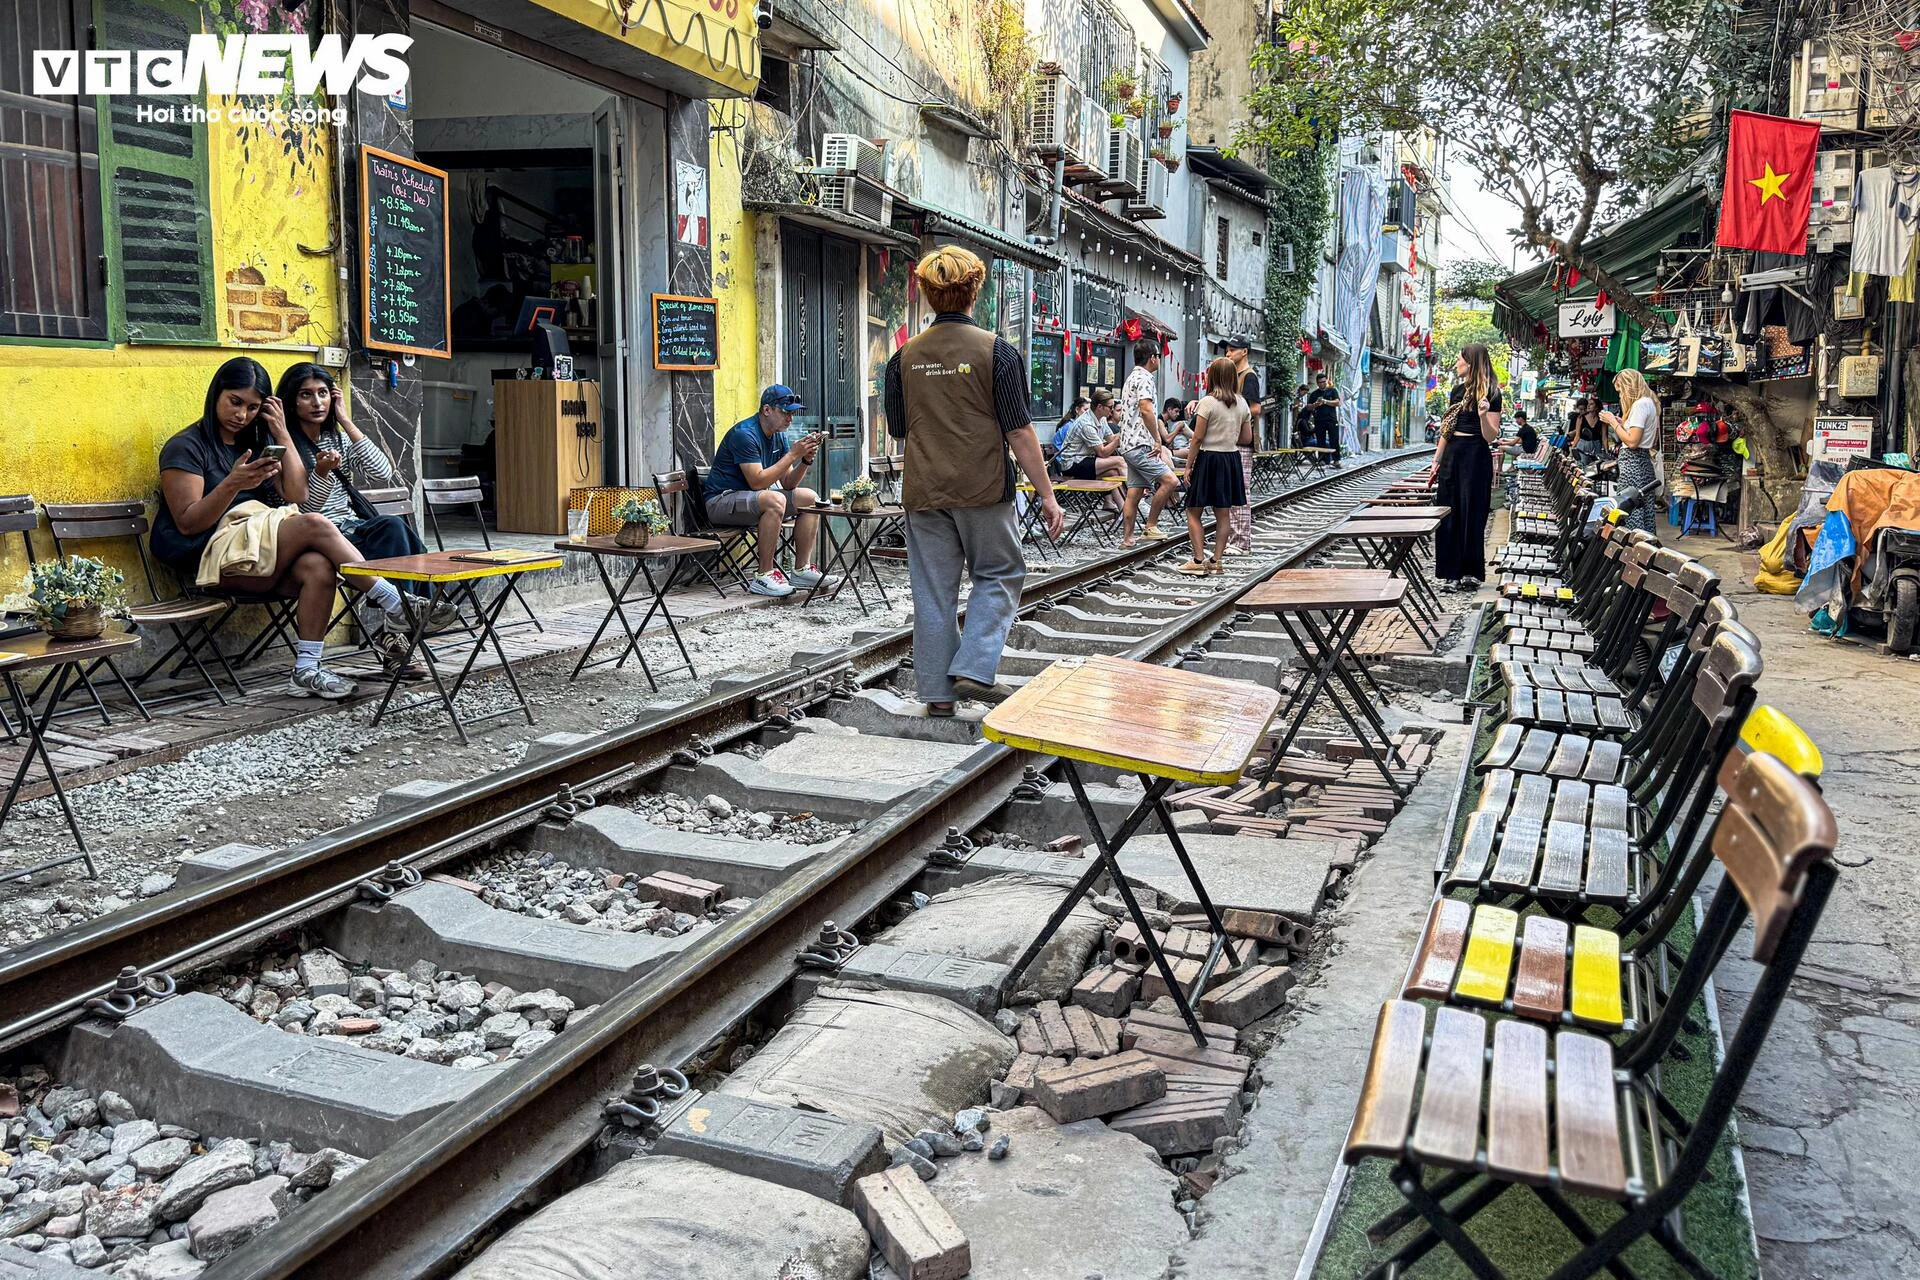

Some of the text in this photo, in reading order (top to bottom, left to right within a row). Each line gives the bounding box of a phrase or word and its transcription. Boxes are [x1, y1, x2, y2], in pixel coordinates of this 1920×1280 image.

[401, 168, 437, 195] Schedule
[1568, 308, 1605, 328] Lyly
[1816, 421, 1848, 430] FUNK25
